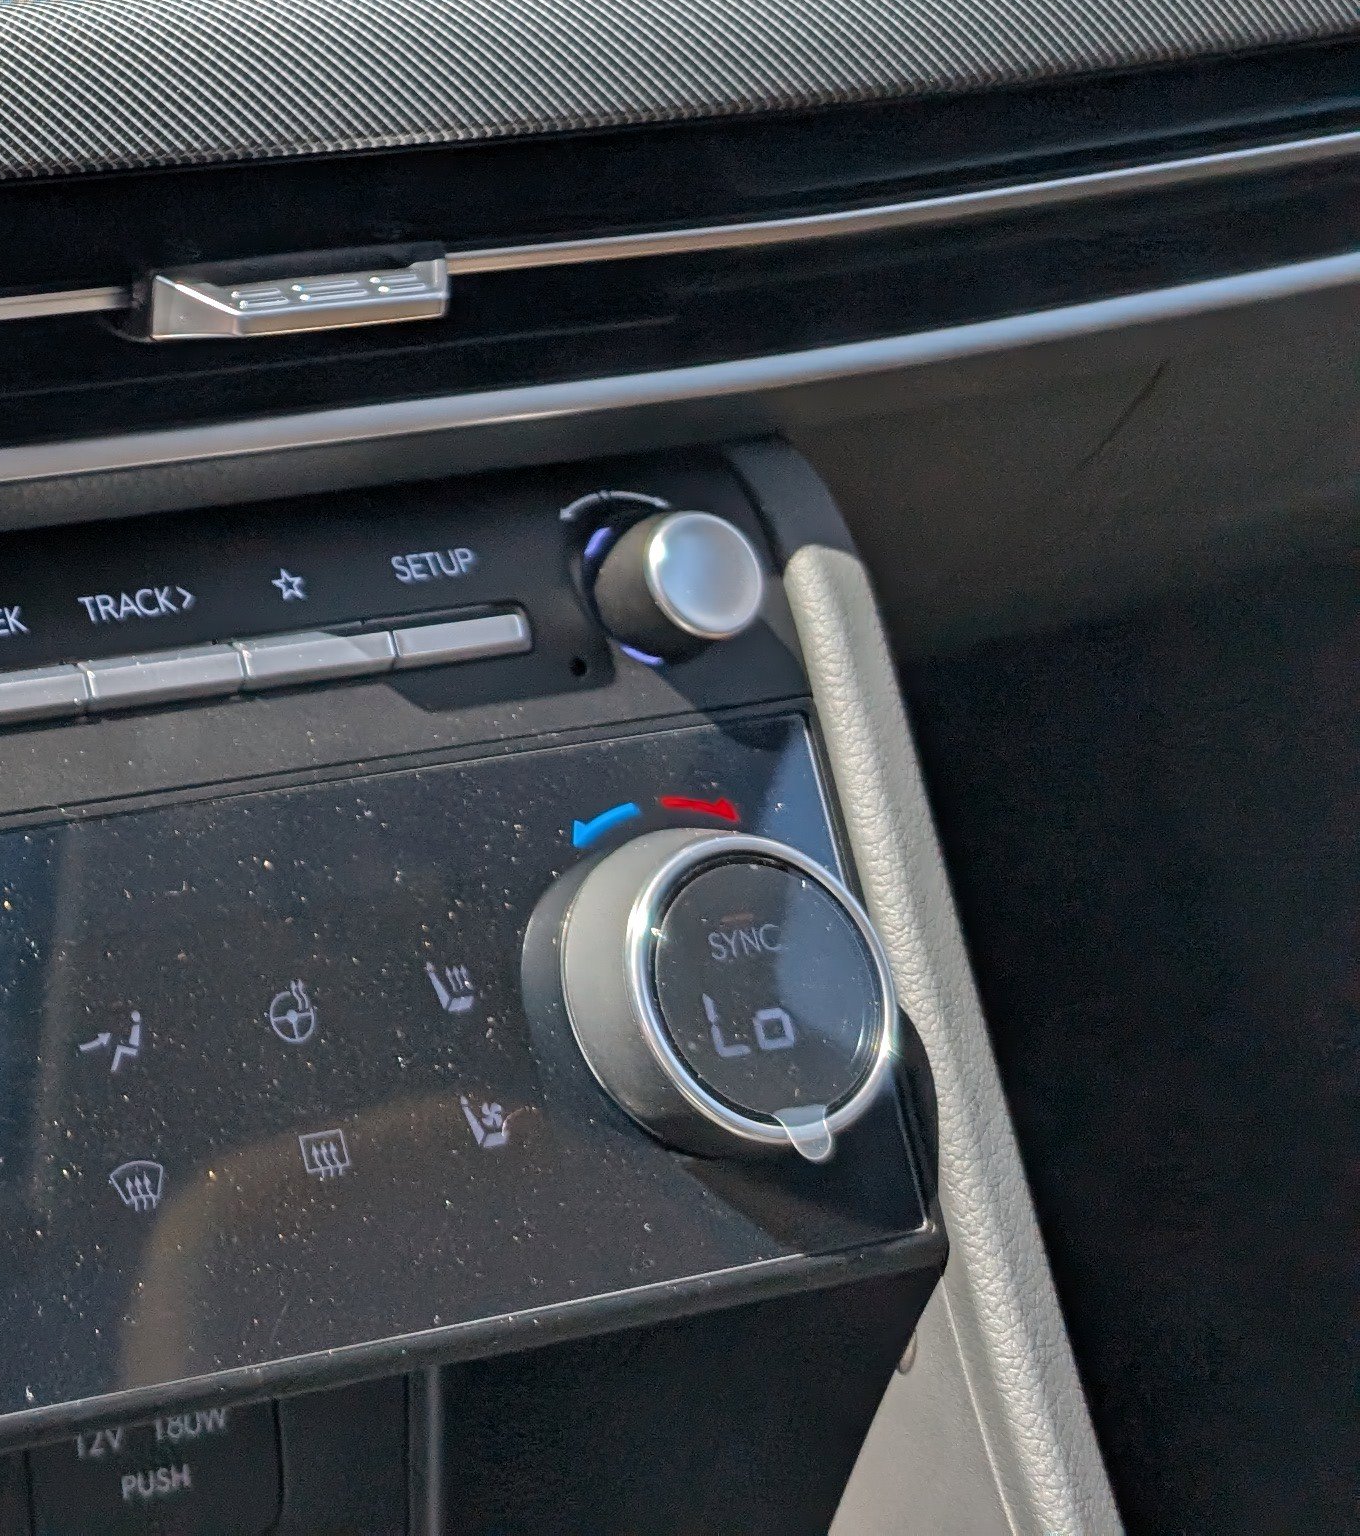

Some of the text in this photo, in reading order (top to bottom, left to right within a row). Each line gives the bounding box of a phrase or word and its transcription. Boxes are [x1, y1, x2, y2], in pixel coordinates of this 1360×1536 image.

[391, 547, 477, 585] SETUP
[707, 923, 782, 961] SYNC
[76, 1425, 124, 1459] 12V
[120, 1463, 192, 1502] PUSH
